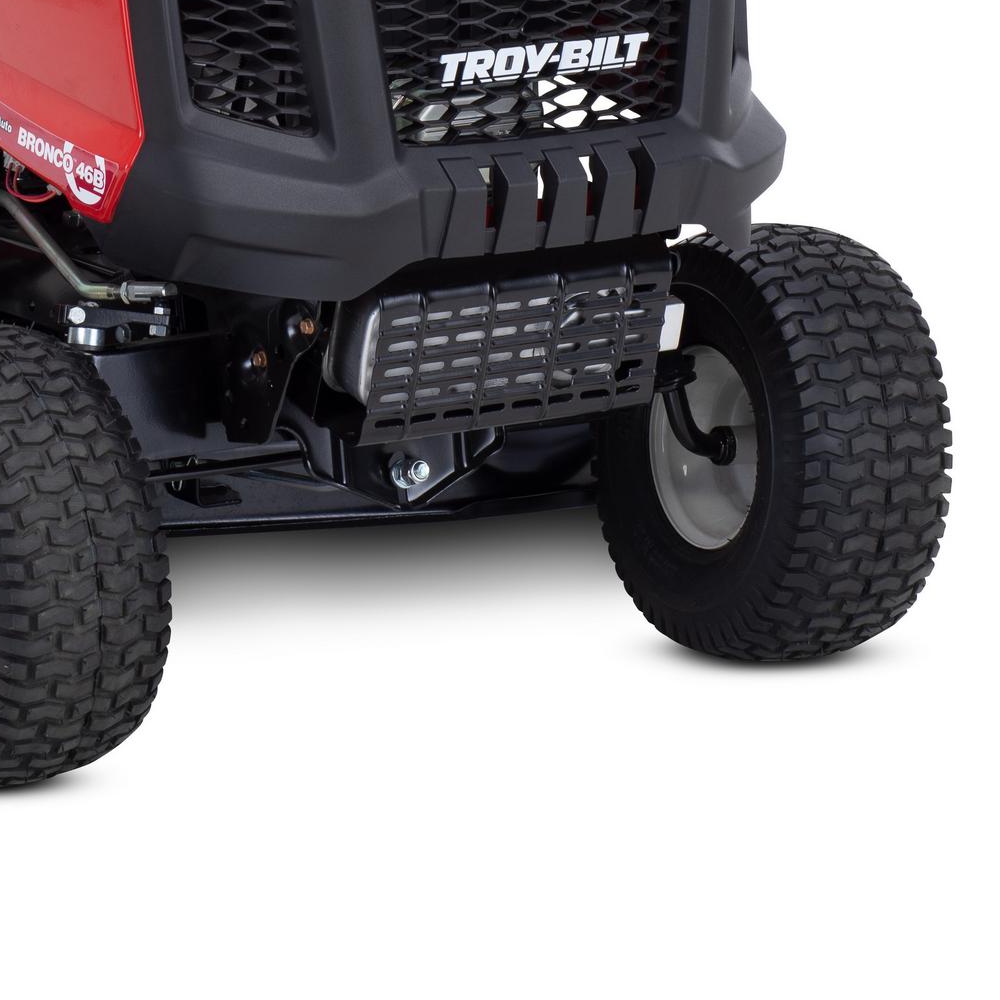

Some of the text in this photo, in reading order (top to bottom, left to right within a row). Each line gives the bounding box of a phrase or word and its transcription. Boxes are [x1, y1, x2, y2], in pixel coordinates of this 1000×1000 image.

[440, 32, 650, 88] TROY-BILT
[17, 126, 74, 173] BRONCO
[75, 161, 105, 189] 46B
